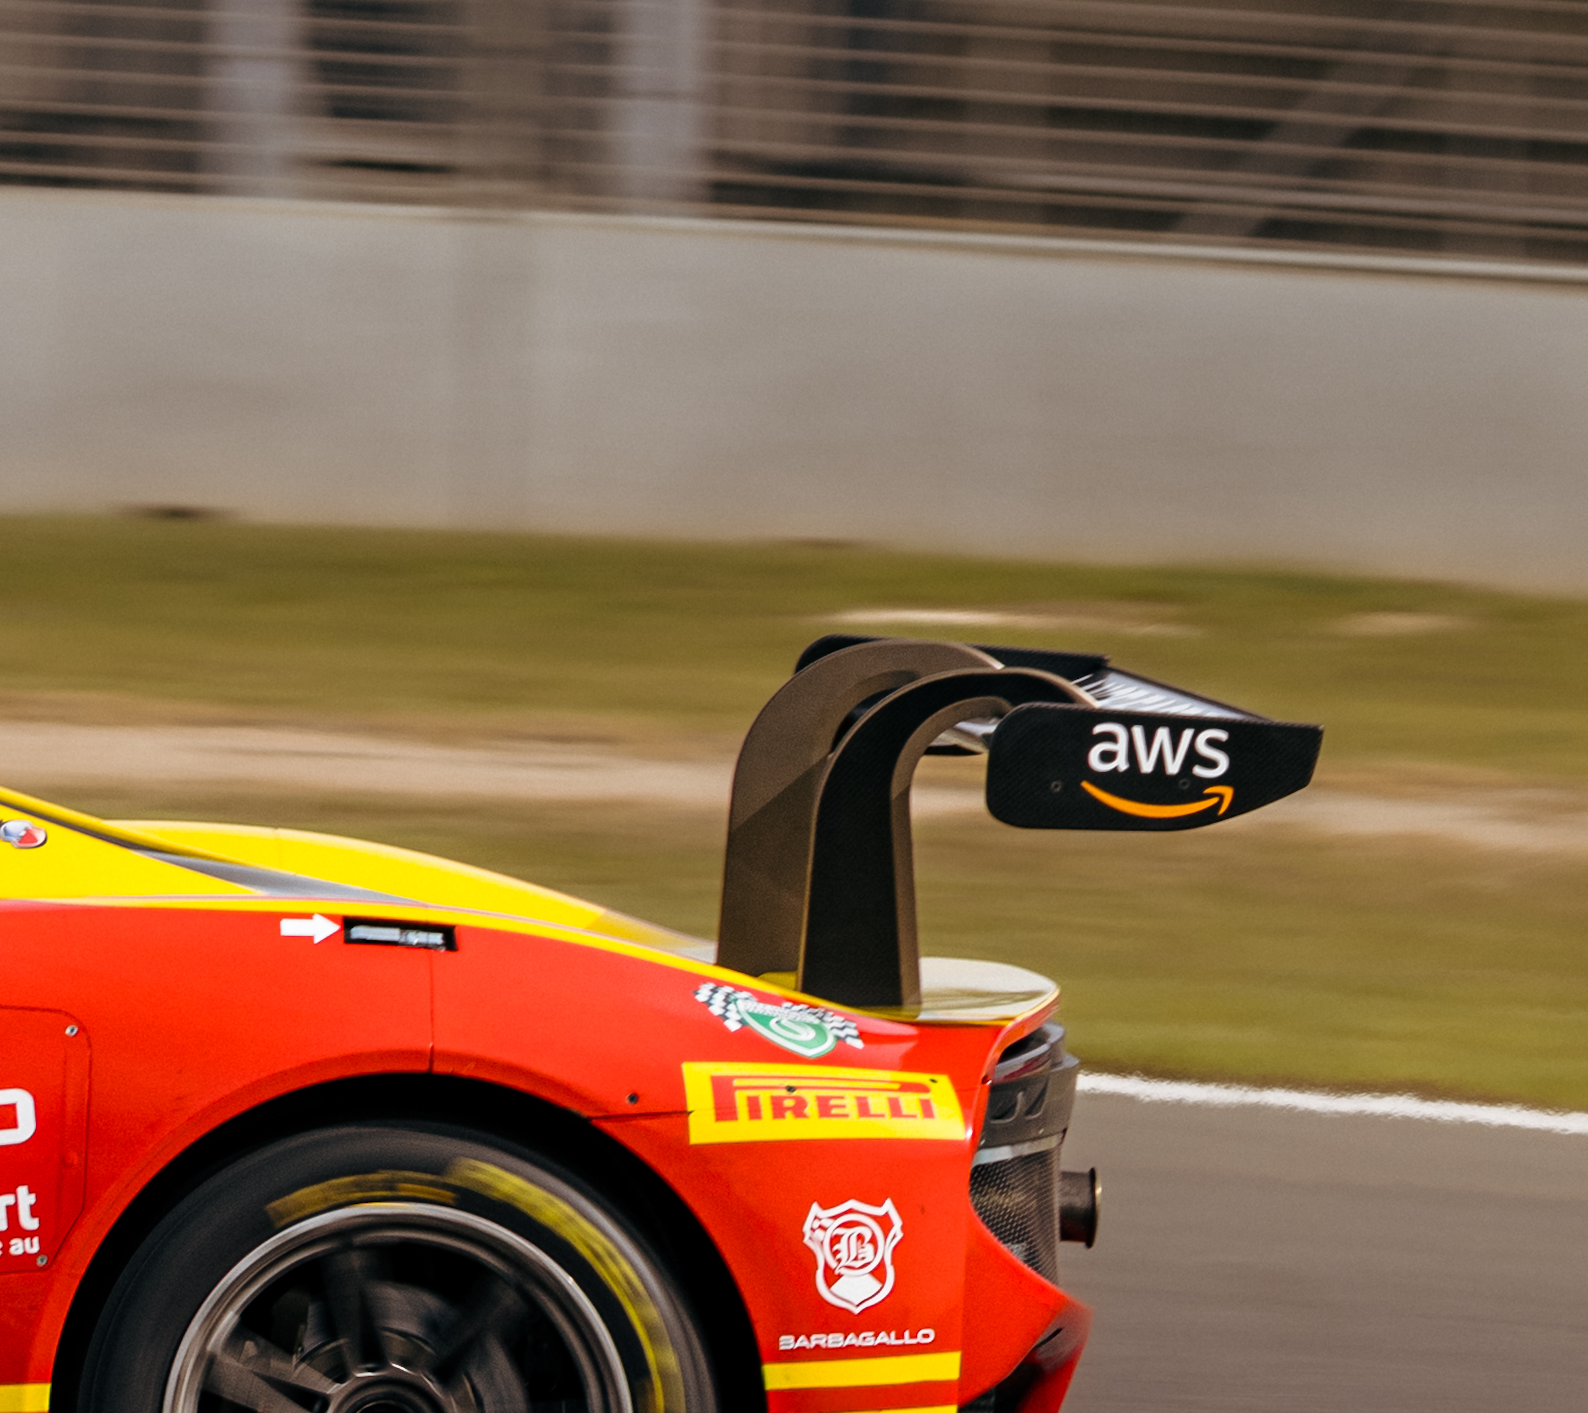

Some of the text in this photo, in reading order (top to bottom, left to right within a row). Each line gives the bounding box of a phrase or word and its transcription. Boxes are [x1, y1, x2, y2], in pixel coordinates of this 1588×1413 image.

[1087, 721, 1230, 779] aws
[710, 1075, 935, 1123] PIRELLI
[779, 1328, 935, 1350] BARBAGALLO
